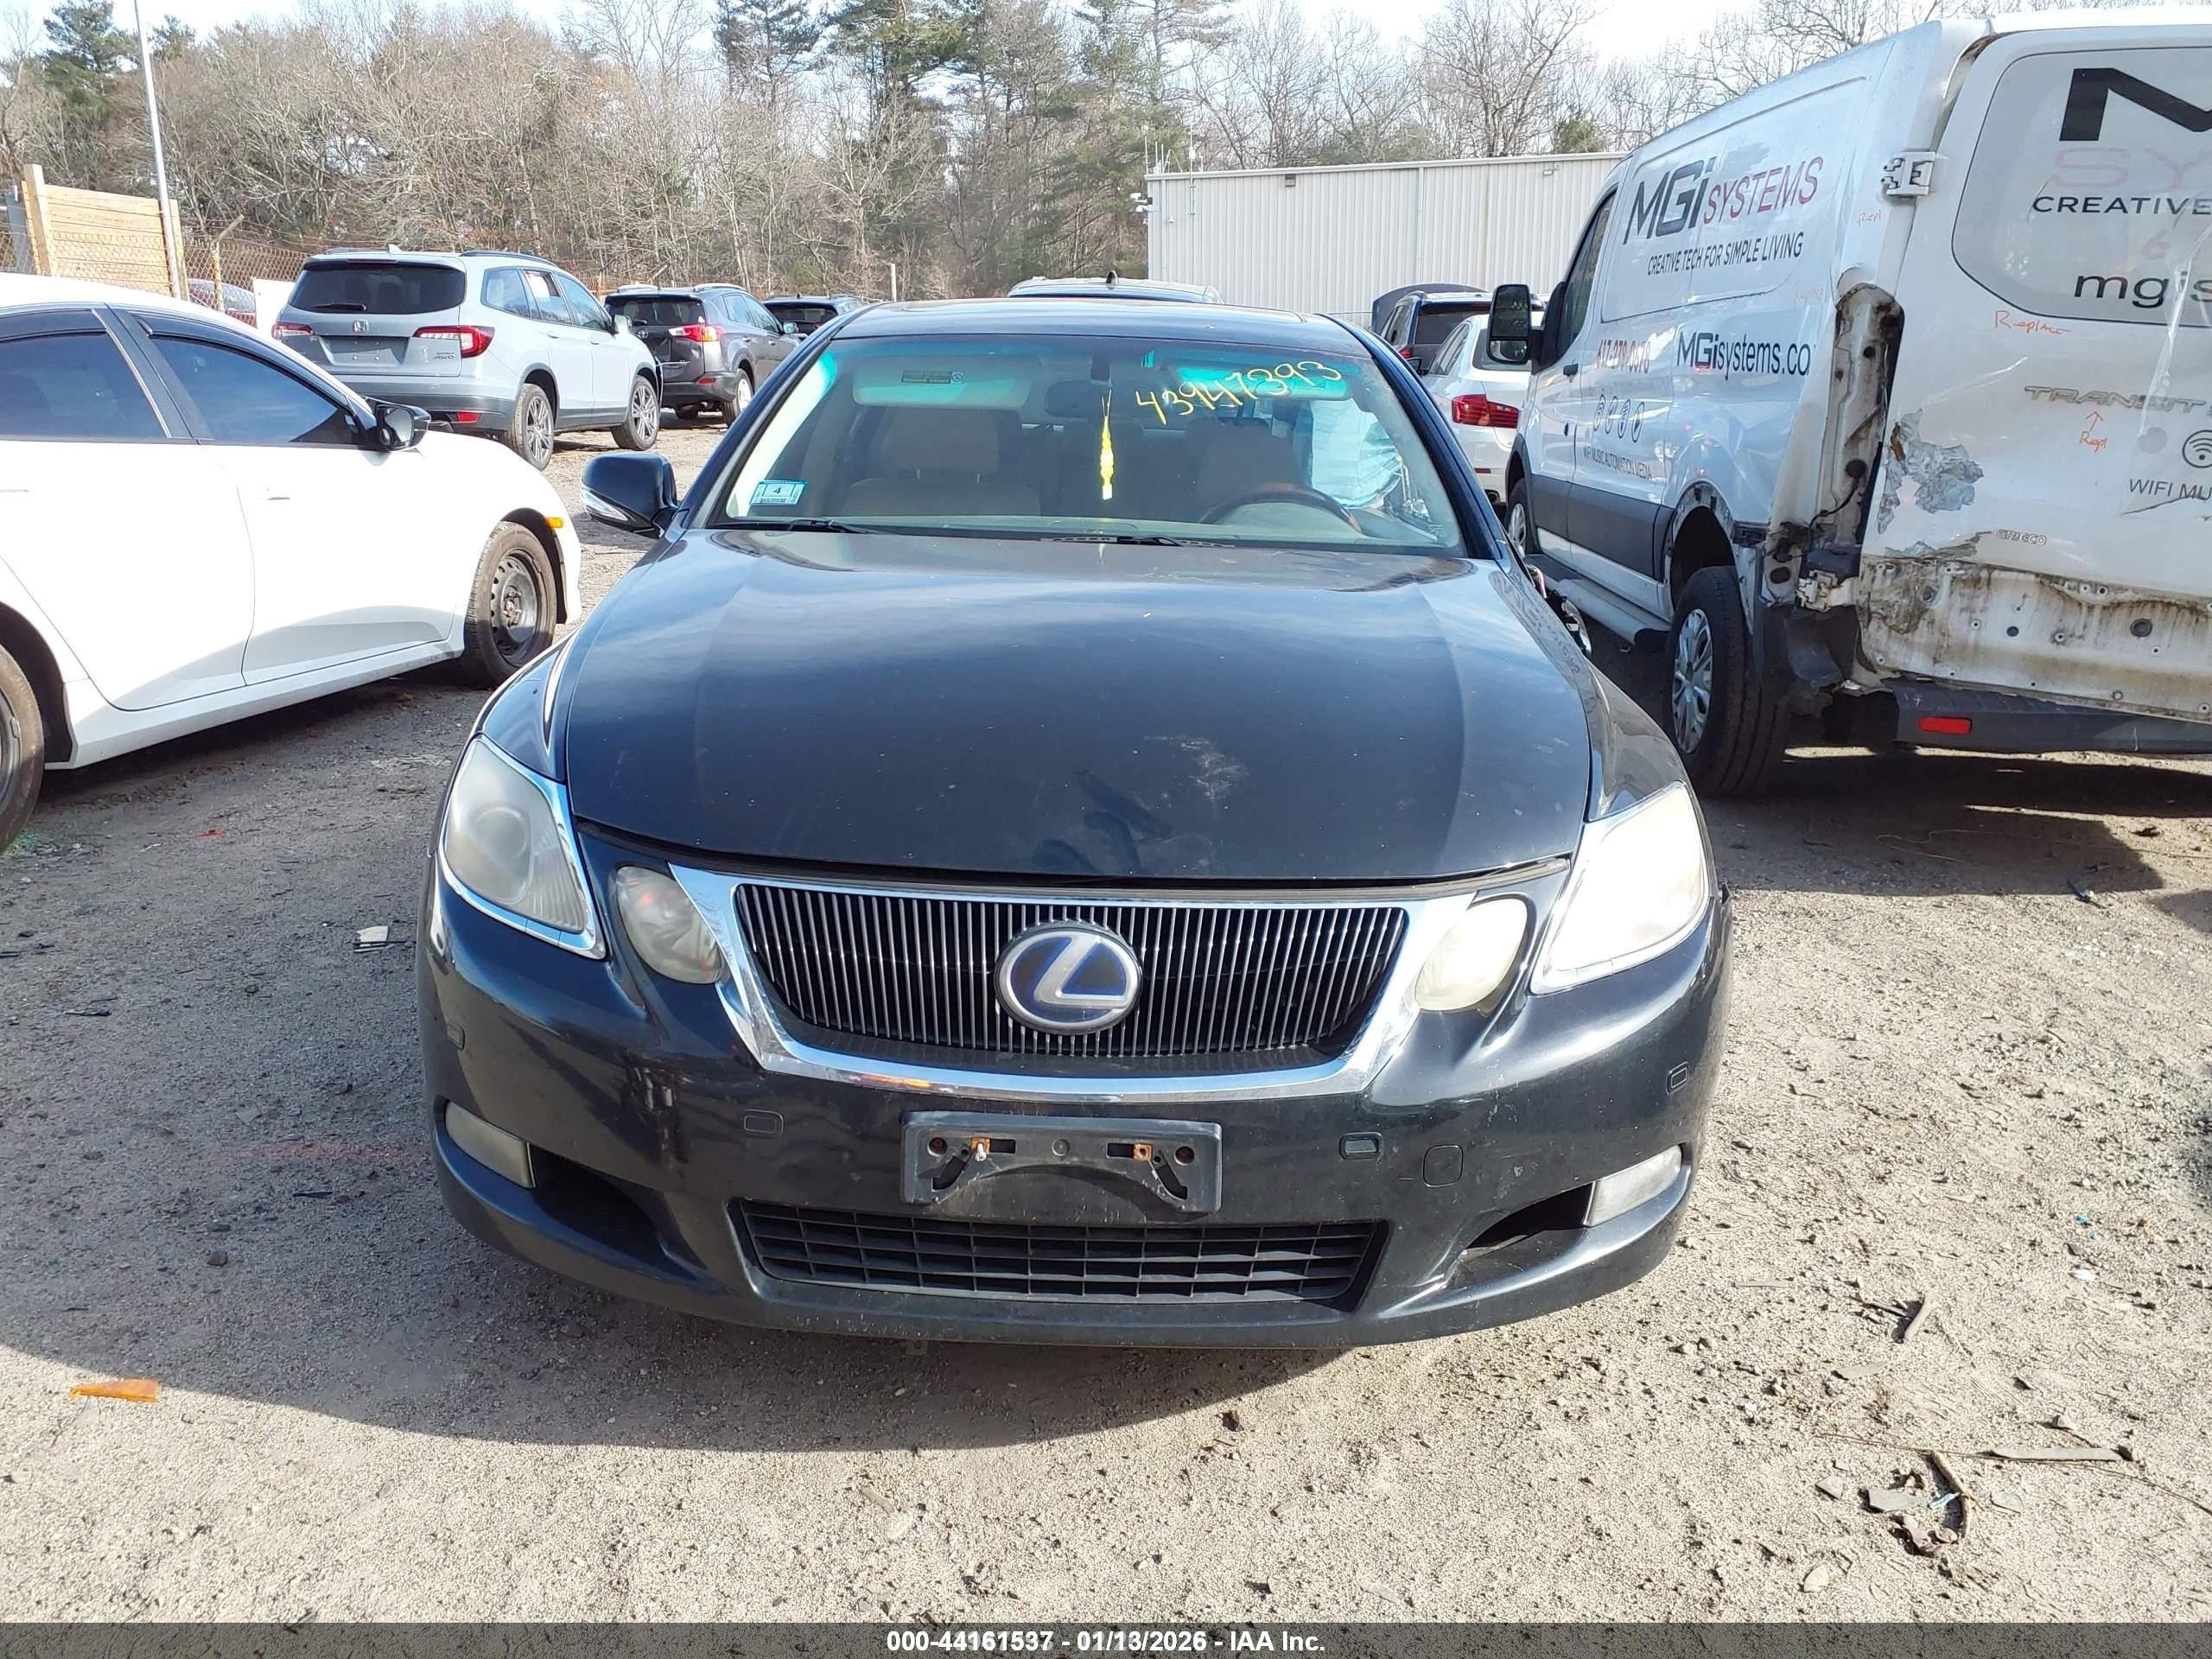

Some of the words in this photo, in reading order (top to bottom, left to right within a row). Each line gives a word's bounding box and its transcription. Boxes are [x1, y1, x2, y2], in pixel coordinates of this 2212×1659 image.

[2033, 195, 2212, 215] CREATIVE
[1648, 250, 1682, 276] CREATIVE
[1683, 248, 1703, 270] TECH
[1705, 245, 1724, 268] FOR
[1724, 238, 1762, 265] SIMPLE
[1762, 232, 1804, 261] LIVING
[1676, 332, 1811, 380] MGisystems.co
[2128, 478, 2174, 498] WIFI
